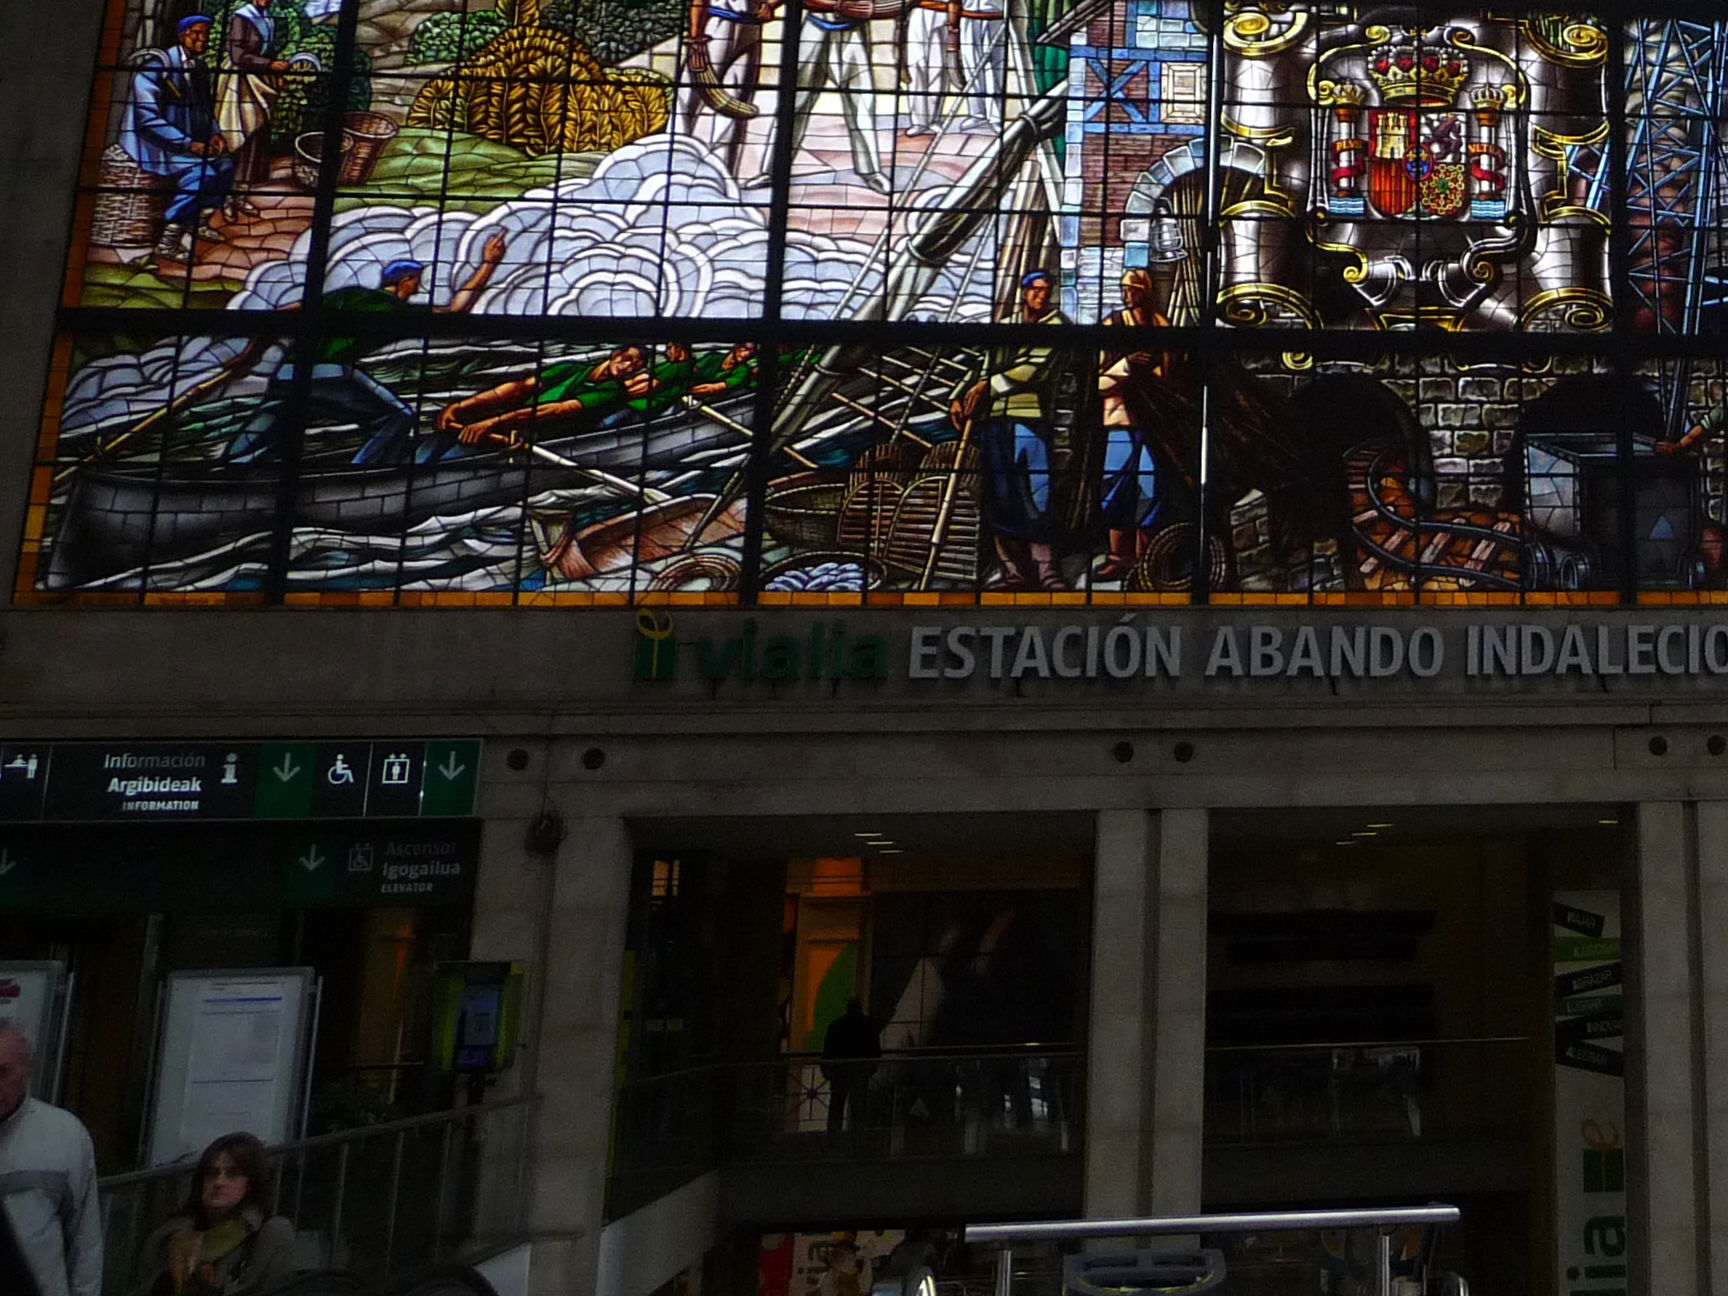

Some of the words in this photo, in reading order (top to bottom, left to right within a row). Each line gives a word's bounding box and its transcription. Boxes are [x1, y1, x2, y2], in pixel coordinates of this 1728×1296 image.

[703, 616, 887, 680] vialia
[908, 611, 1183, 680] ESTACIÓN
[1204, 624, 1446, 678] ABANDO
[103, 751, 206, 770] Información
[106, 775, 203, 796] Argibideak
[121, 800, 200, 812] INFORMATION
[384, 840, 458, 856] Ascensor
[381, 859, 461, 880] Igogailua
[380, 882, 434, 893] ELEVATOR
